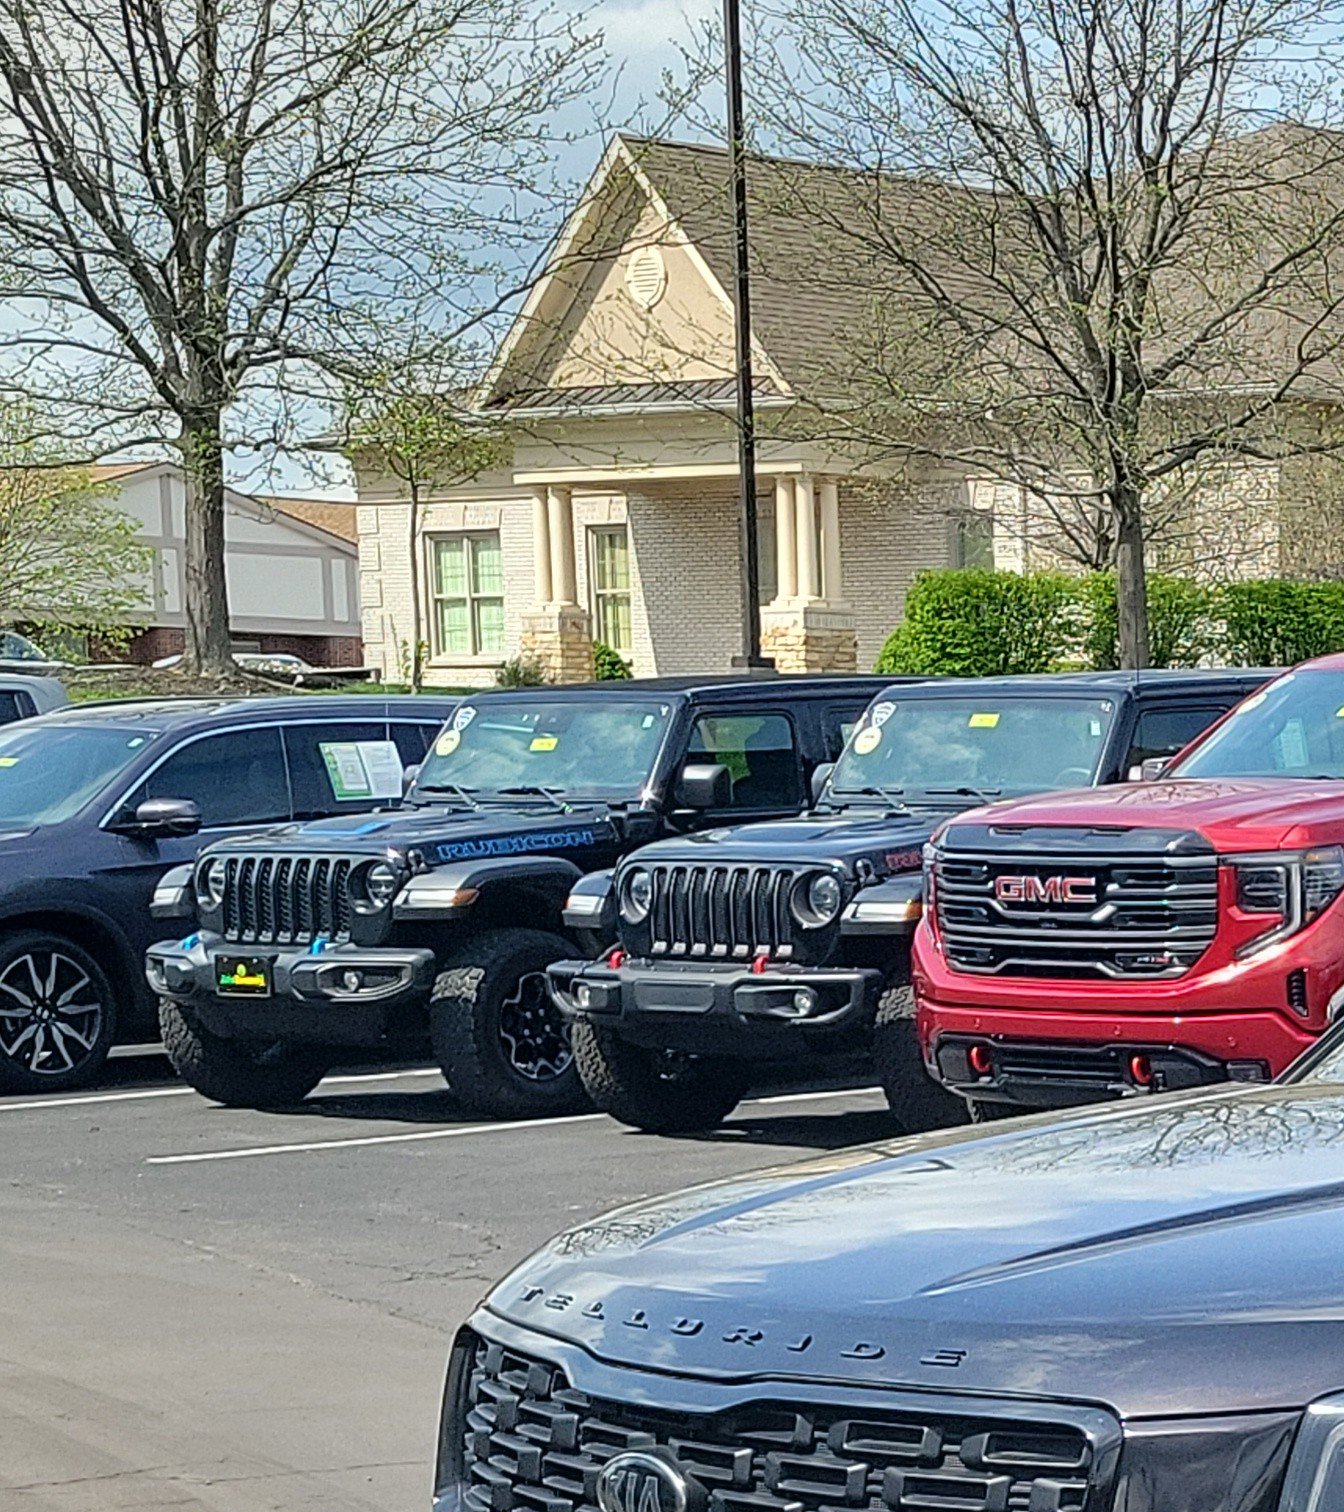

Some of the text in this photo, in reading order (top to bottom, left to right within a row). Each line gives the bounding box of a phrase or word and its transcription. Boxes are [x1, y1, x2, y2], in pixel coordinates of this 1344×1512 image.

[437, 831, 594, 862] RUBICON
[995, 875, 1096, 903] GMC
[520, 1285, 968, 1368] TELLURIDE
